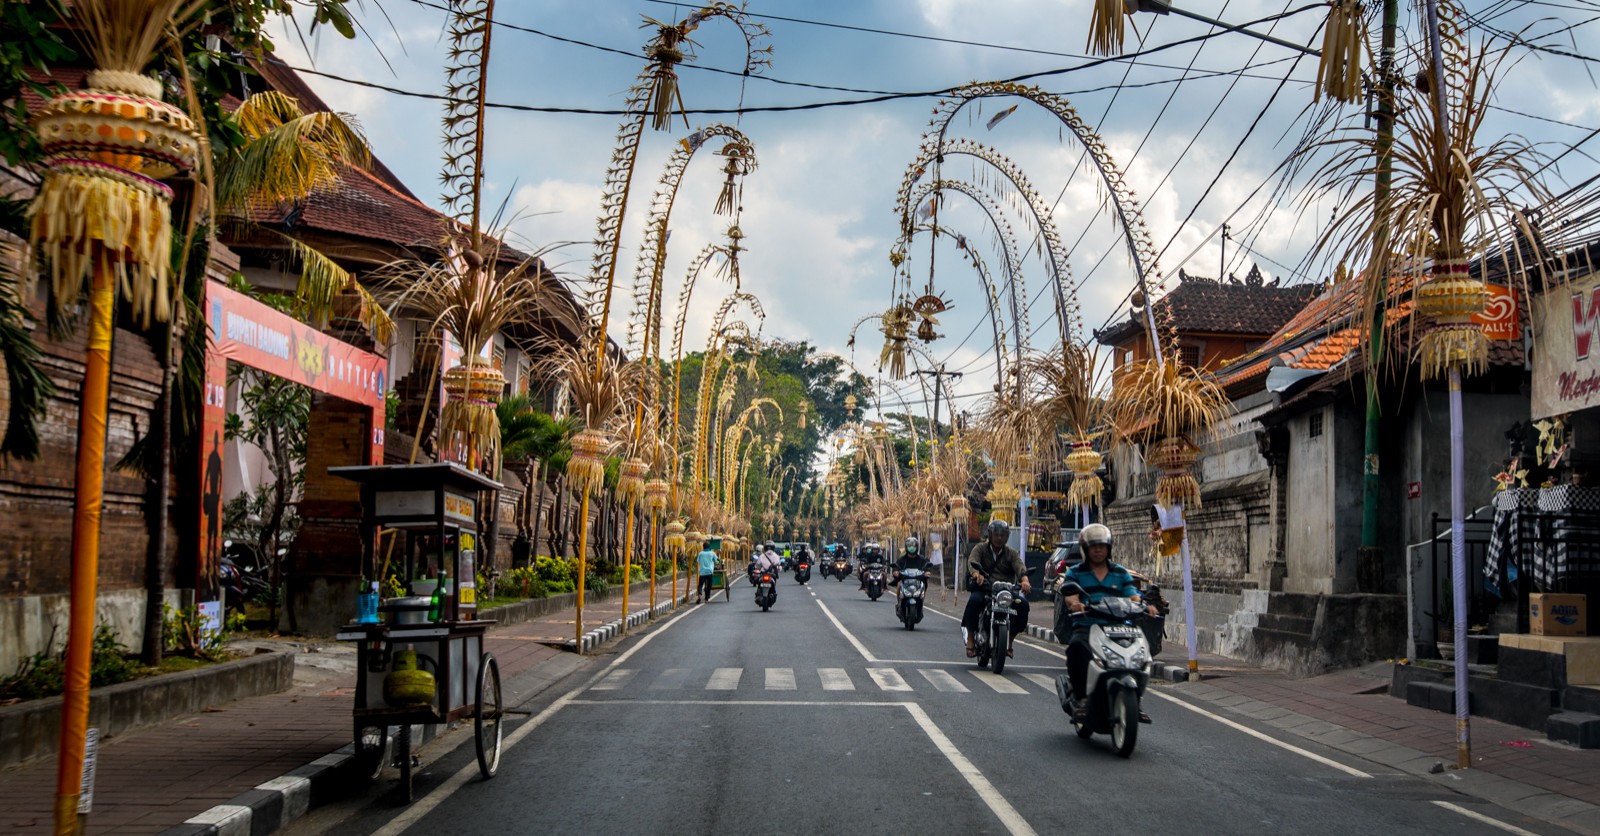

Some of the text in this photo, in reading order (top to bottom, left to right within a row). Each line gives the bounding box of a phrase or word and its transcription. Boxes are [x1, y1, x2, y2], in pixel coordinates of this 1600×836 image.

[227, 312, 257, 348] BUPATI
[258, 323, 289, 362] BADUNG
[329, 355, 376, 392] BATTLE
